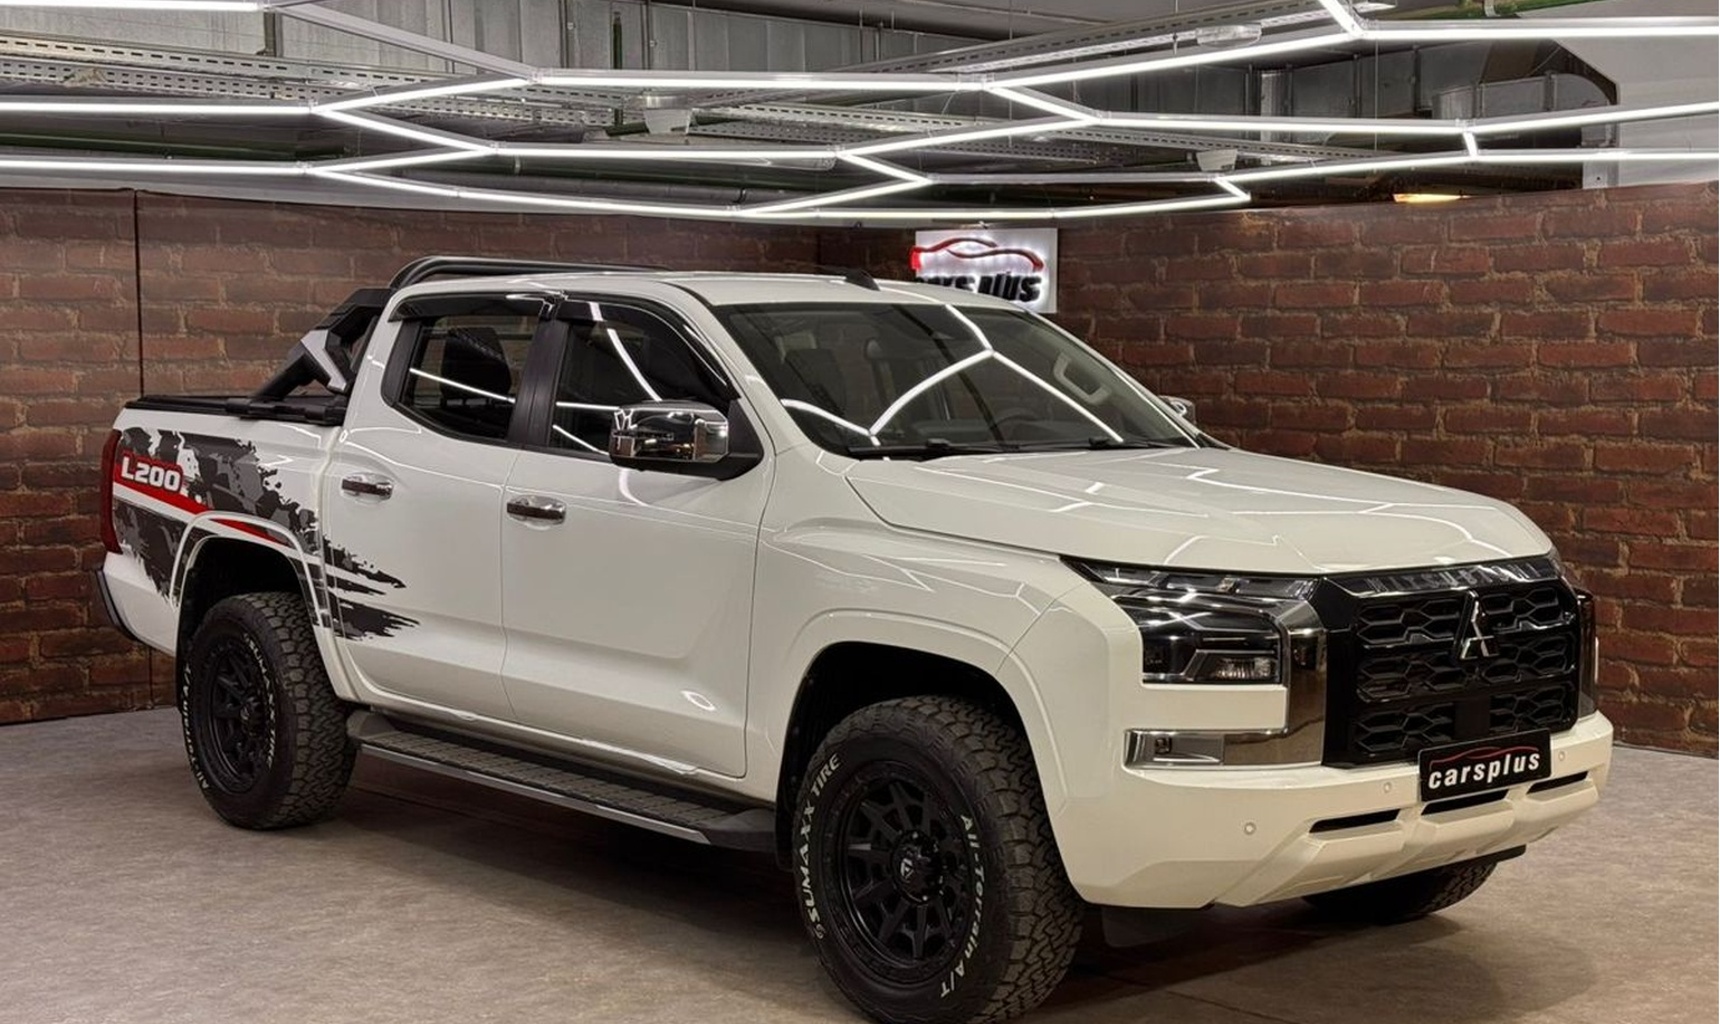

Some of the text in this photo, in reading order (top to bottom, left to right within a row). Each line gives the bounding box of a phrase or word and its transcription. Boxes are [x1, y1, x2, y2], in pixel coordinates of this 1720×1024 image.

[121, 455, 180, 492] L200
[1428, 752, 1540, 789] carsplus
[799, 752, 842, 923] SUMAXX TIRE
[960, 814, 986, 959] All-Terrain
